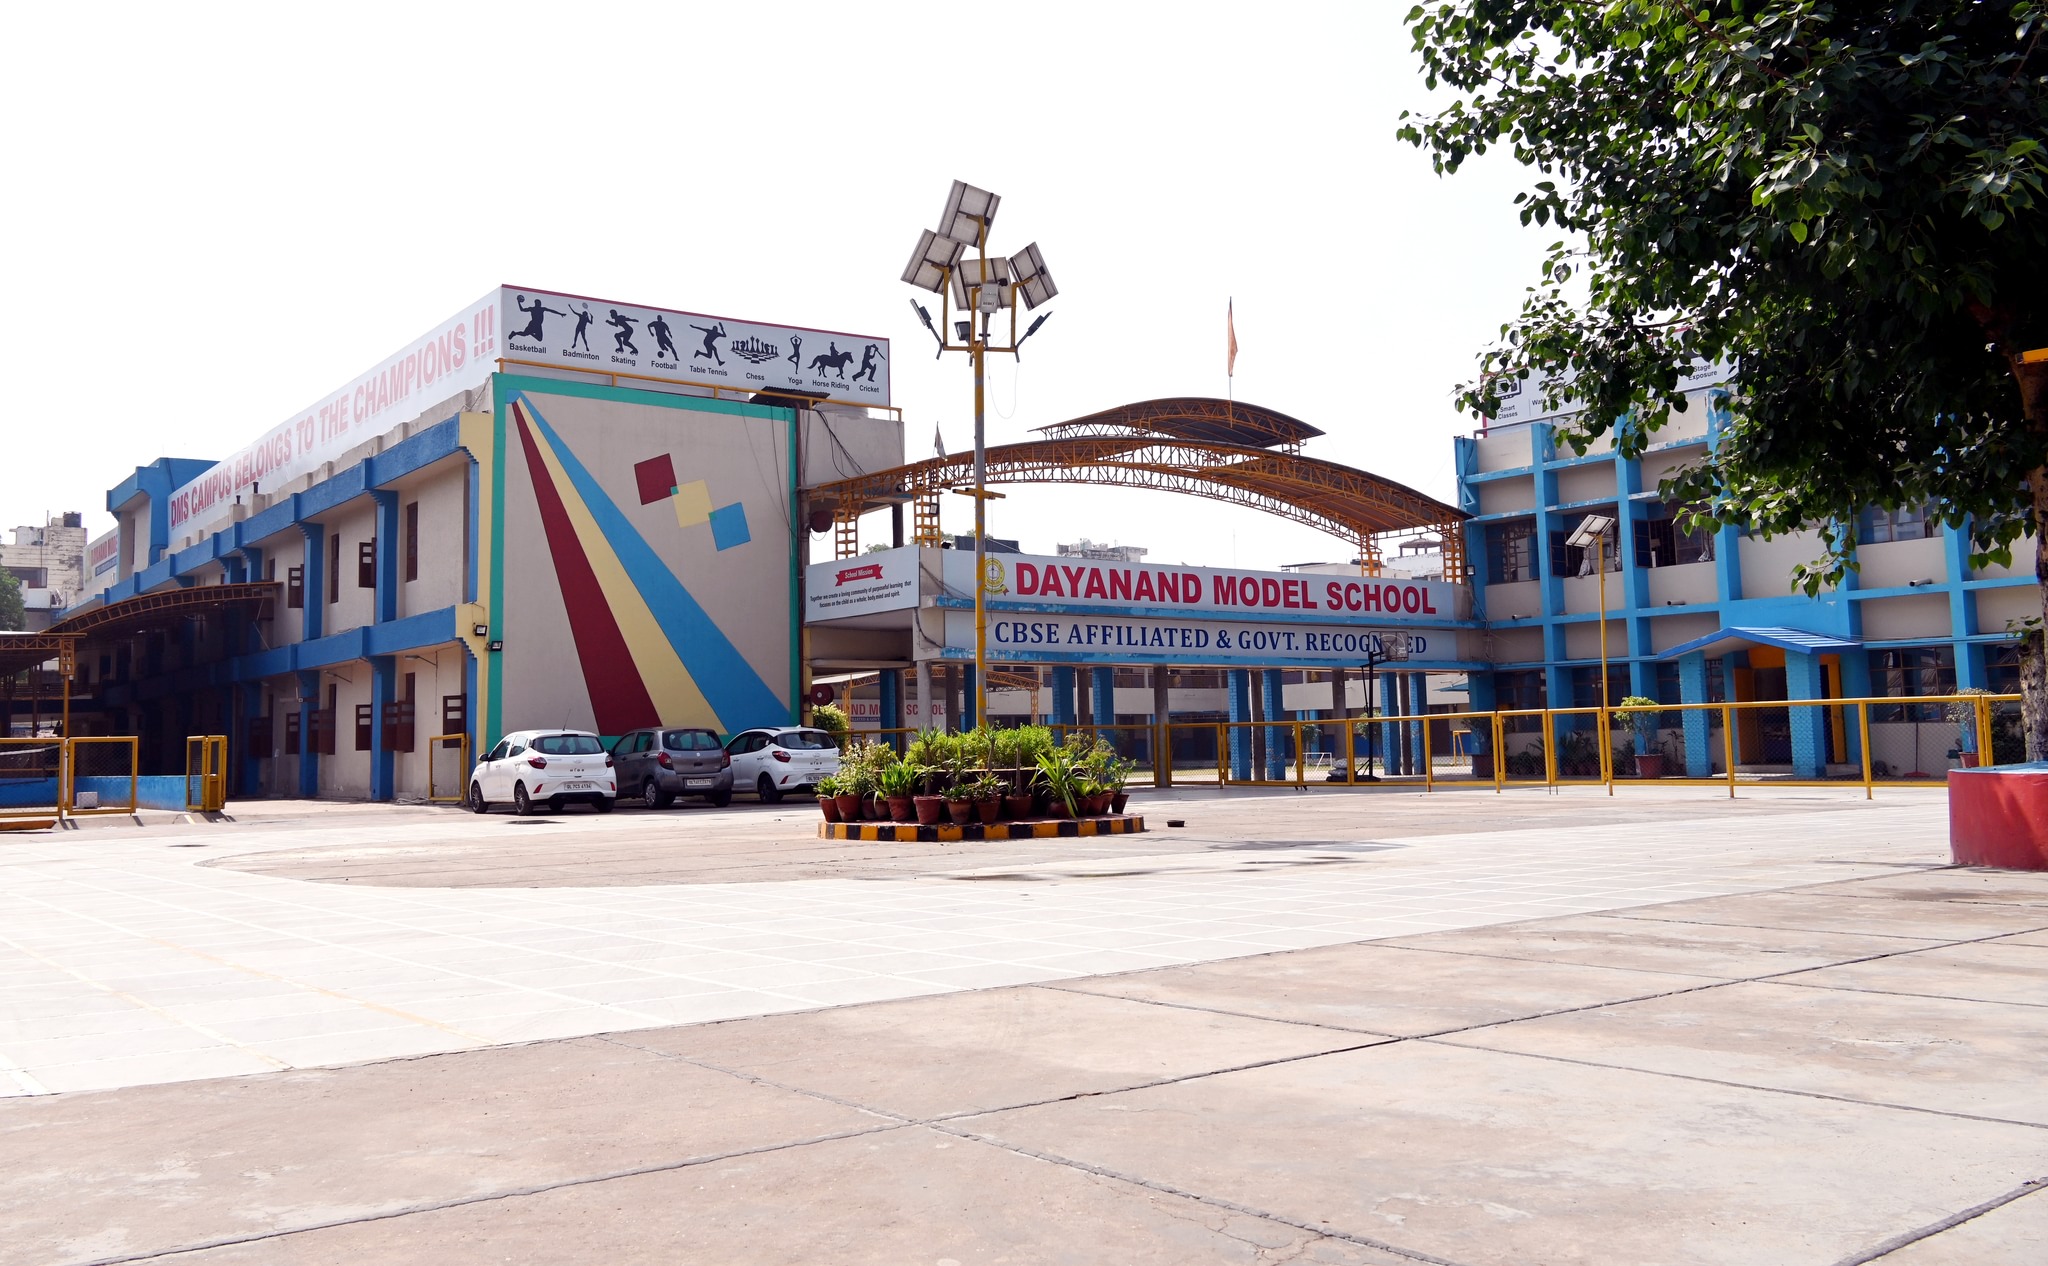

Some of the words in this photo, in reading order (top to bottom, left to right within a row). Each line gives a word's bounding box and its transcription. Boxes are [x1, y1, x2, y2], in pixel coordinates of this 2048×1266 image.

[509, 343, 547, 354] Basketball
[562, 349, 600, 361] Badminton
[611, 355, 636, 367] Skating
[651, 360, 677, 370] Football
[689, 365, 706, 374] Table
[707, 367, 728, 377] Tennis
[1694, 364, 1711, 373] Stage
[745, 372, 765, 381] Chess
[787, 376, 803, 385] Yoga
[1688, 370, 1718, 381] Exposure
[812, 379, 830, 388] Horse
[831, 381, 850, 391] Riding
[859, 385, 880, 393] Cricket
[1499, 404, 1516, 413] Smart
[1497, 411, 1518, 420] Classes
[171, 491, 189, 528] DMS
[191, 464, 232, 515] CAMPUS
[234, 427, 292, 495] BELONGS
[296, 415, 315, 456] TO
[319, 393, 350, 443] THE
[353, 322, 466, 424] CHAMPIONS
[1016, 562, 1202, 604] DAYANAND
[1213, 575, 1318, 610] MODEL
[1326, 581, 1437, 615] SCHOOL
[995, 622, 1060, 644] CBSE
[1067, 624, 1209, 648] AFFILIATED
[1216, 629, 1232, 649] &
[1238, 630, 1299, 651] GOVT.
[1305, 633, 1427, 654] RECOGNED
